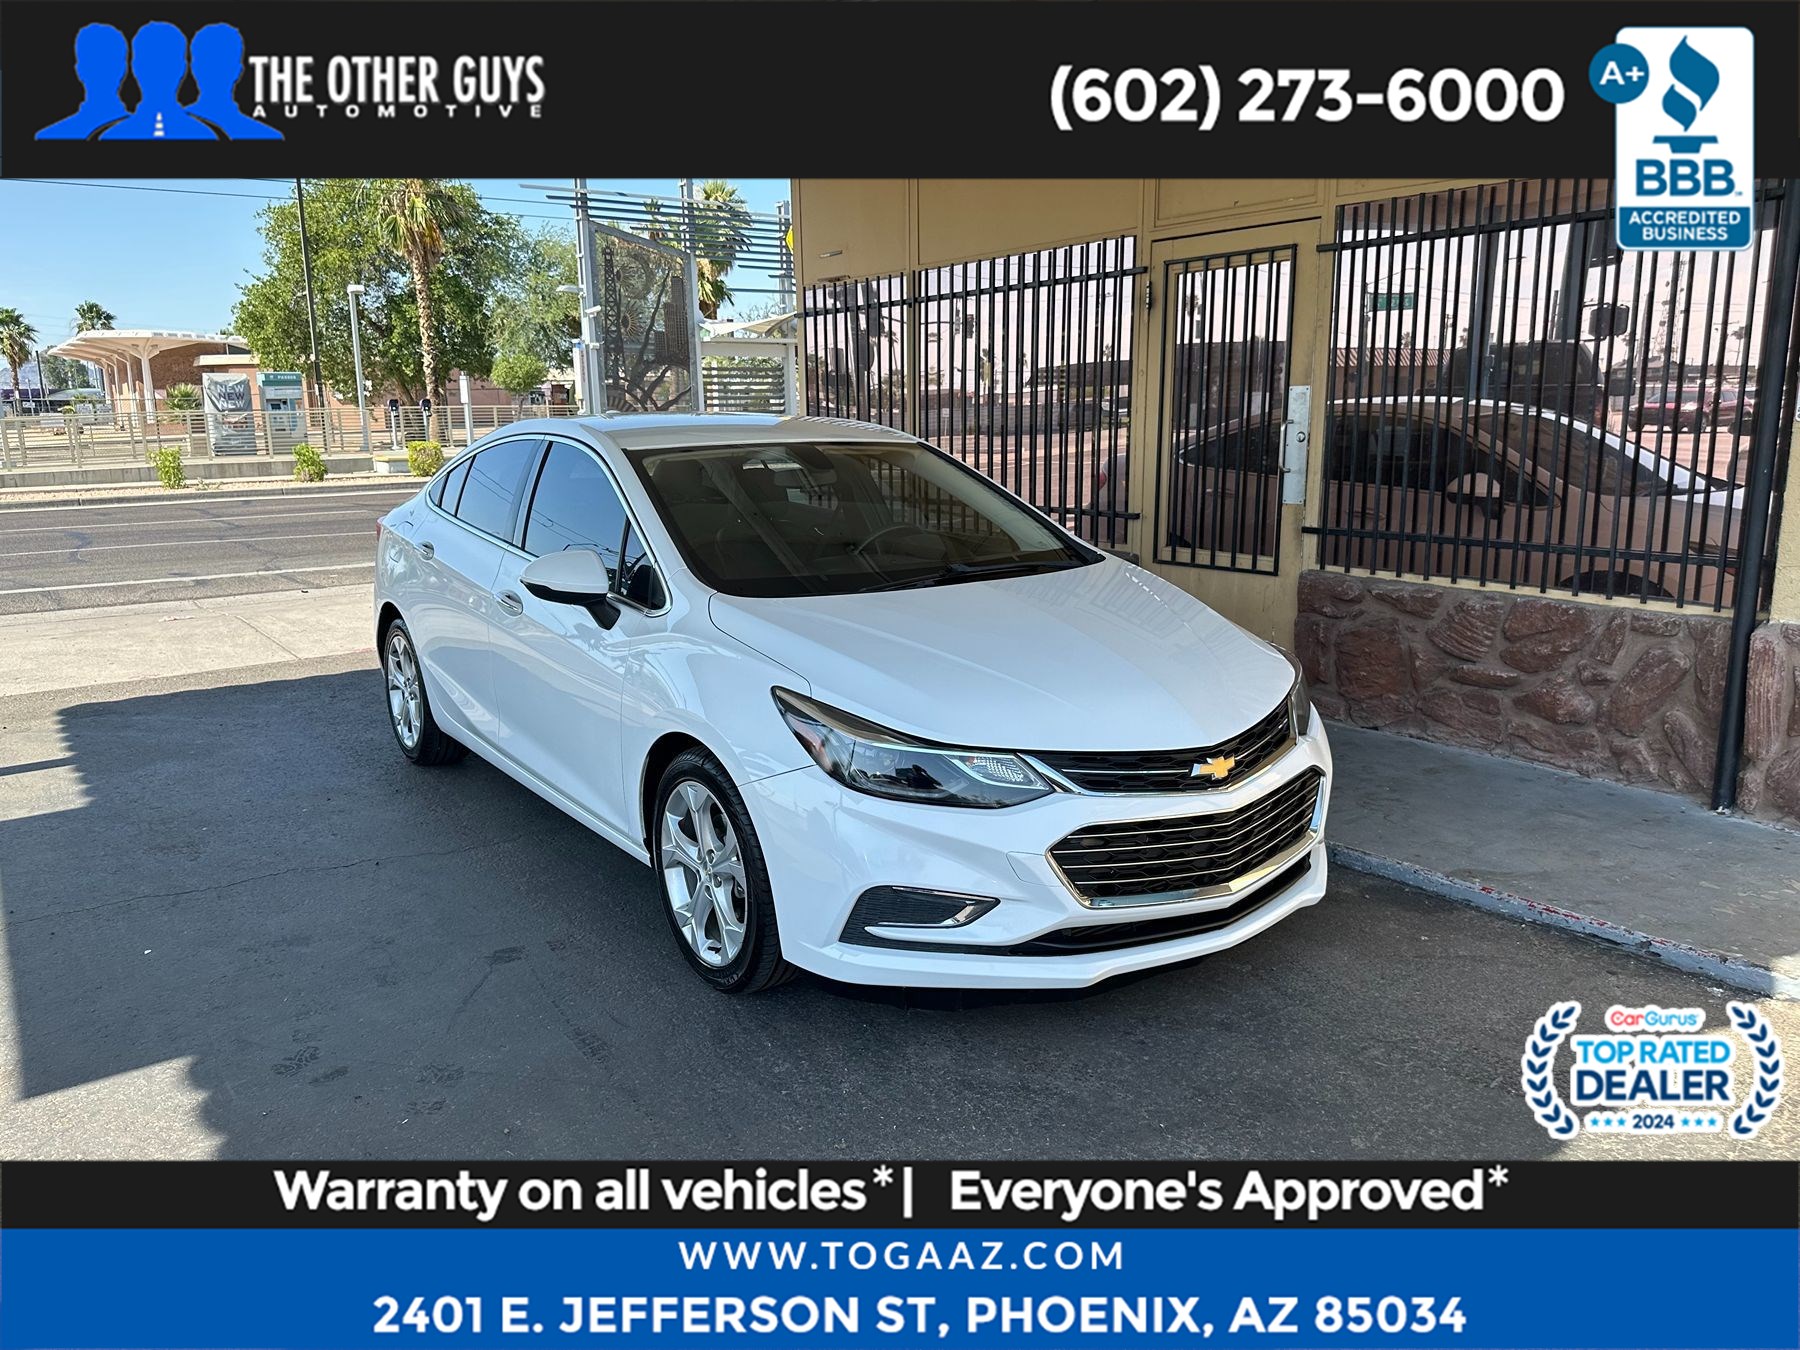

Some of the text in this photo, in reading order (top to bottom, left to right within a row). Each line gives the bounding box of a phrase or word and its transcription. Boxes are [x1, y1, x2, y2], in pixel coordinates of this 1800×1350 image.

[217, 384, 245, 393] NEW
[218, 392, 245, 401] NEW
[219, 400, 246, 409] NEW
